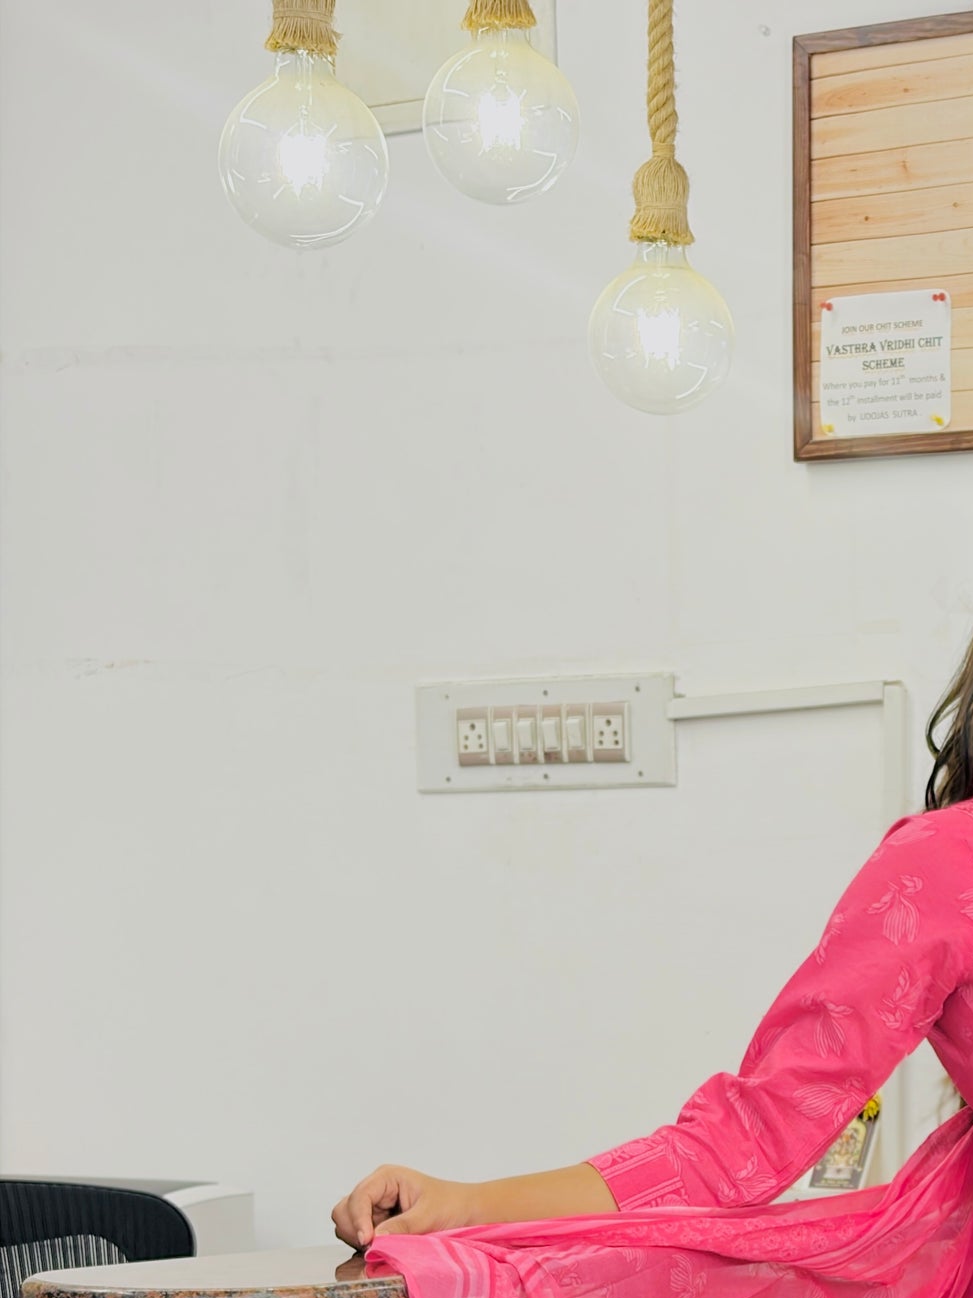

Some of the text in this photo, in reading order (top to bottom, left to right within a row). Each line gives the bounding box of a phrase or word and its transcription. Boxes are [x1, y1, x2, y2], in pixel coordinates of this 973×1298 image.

[841, 320, 923, 334] JOIN OUR CHIT SCHEME
[826, 336, 943, 355] VASTHRA VRIDHI CHIT
[862, 357, 905, 370] SCHEME
[848, 382, 862, 390] you
[863, 380, 877, 389] pay
[878, 378, 889, 386] for
[909, 375, 938, 383] months
[899, 392, 912, 401] will
[914, 391, 924, 400] be
[925, 391, 942, 400] paid
[848, 414, 856, 422] by
